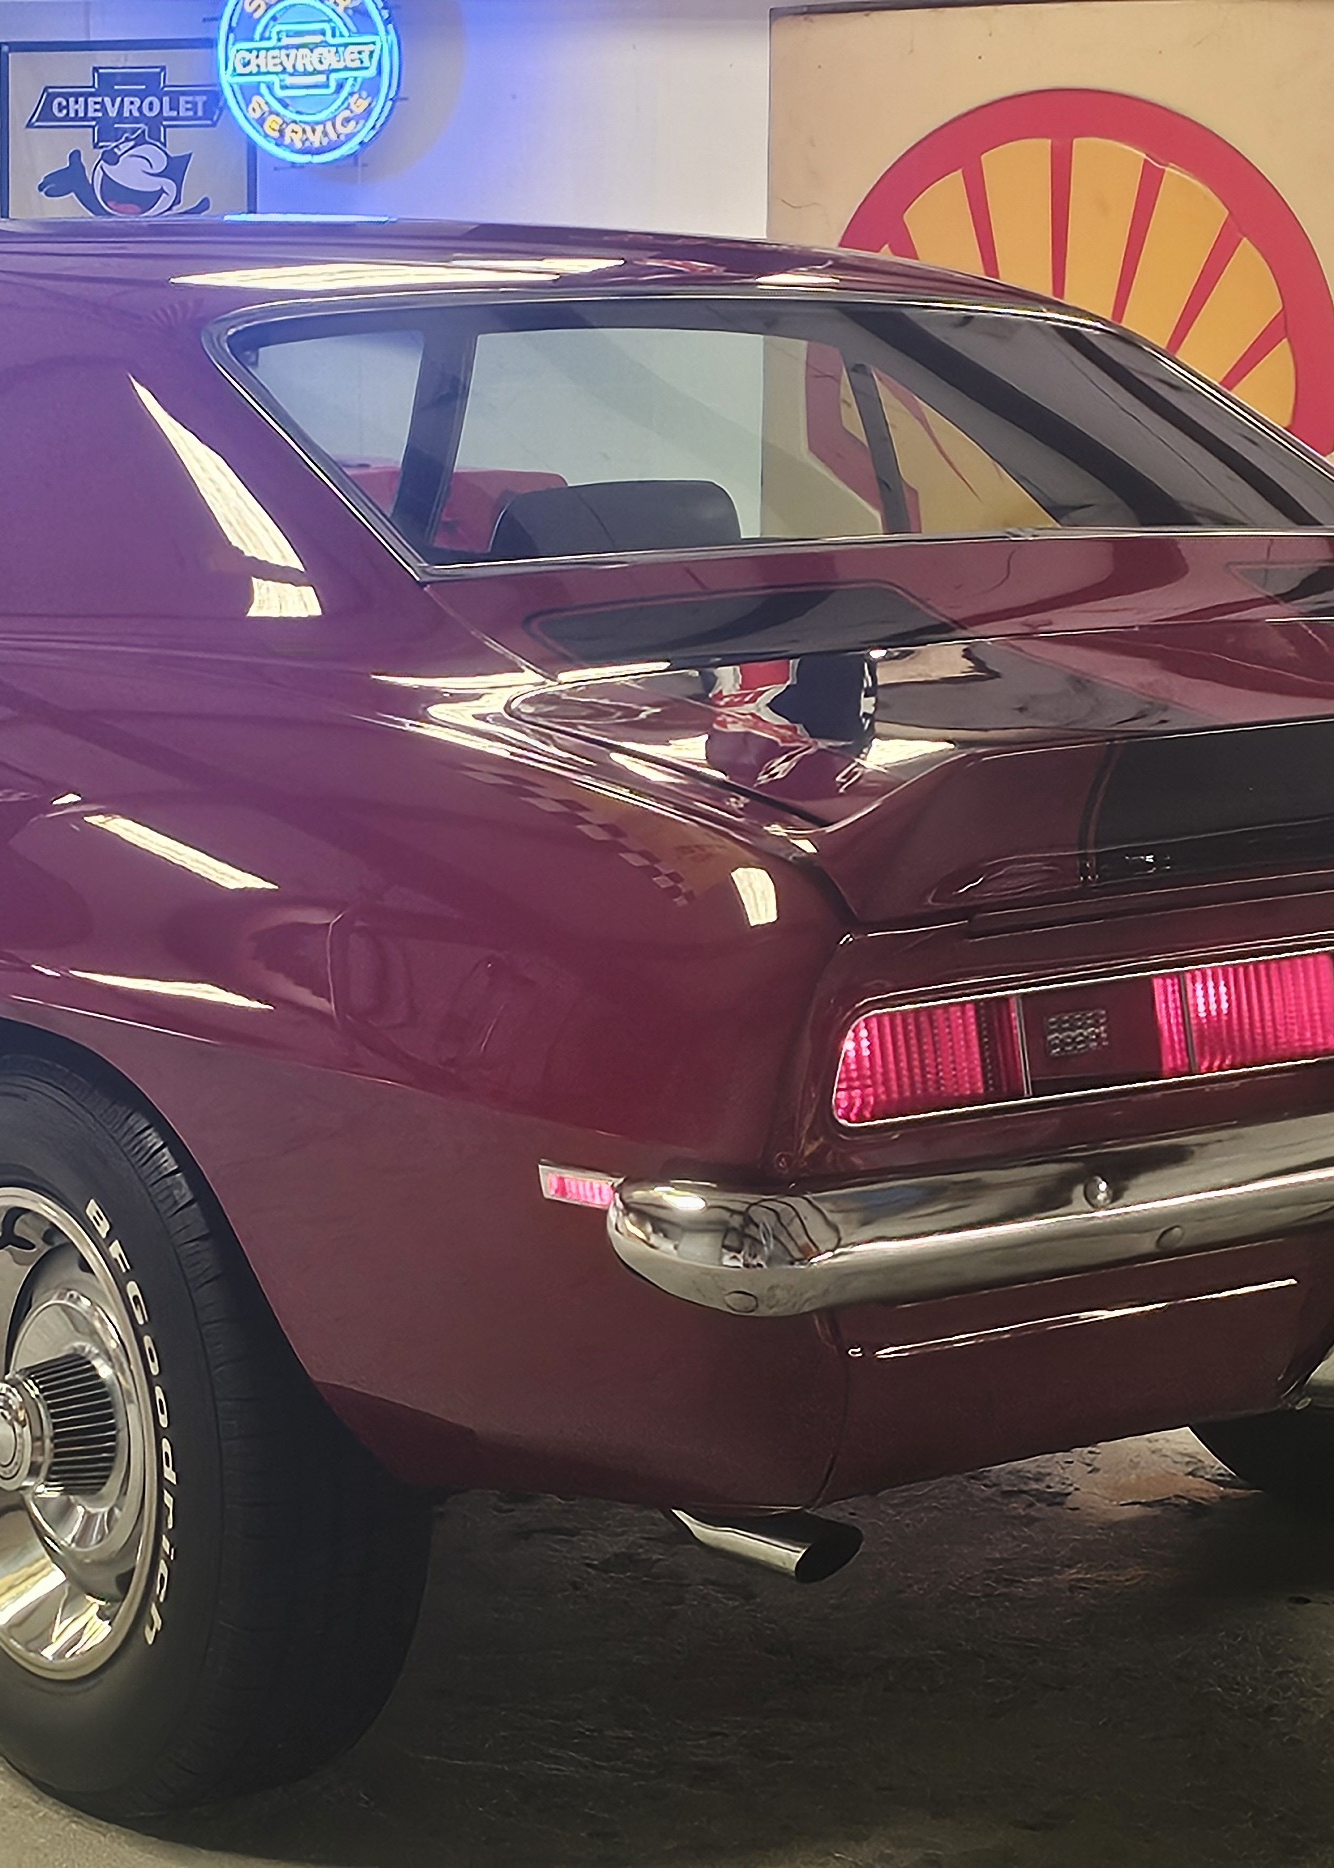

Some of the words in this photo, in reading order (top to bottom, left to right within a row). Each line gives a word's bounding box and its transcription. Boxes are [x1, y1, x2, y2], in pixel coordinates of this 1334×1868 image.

[233, 44, 377, 74] CHEVROLET
[51, 95, 208, 119] CHEVROLET
[248, 91, 371, 149] SERVICE
[85, 1199, 179, 1645] BFGoodrich
